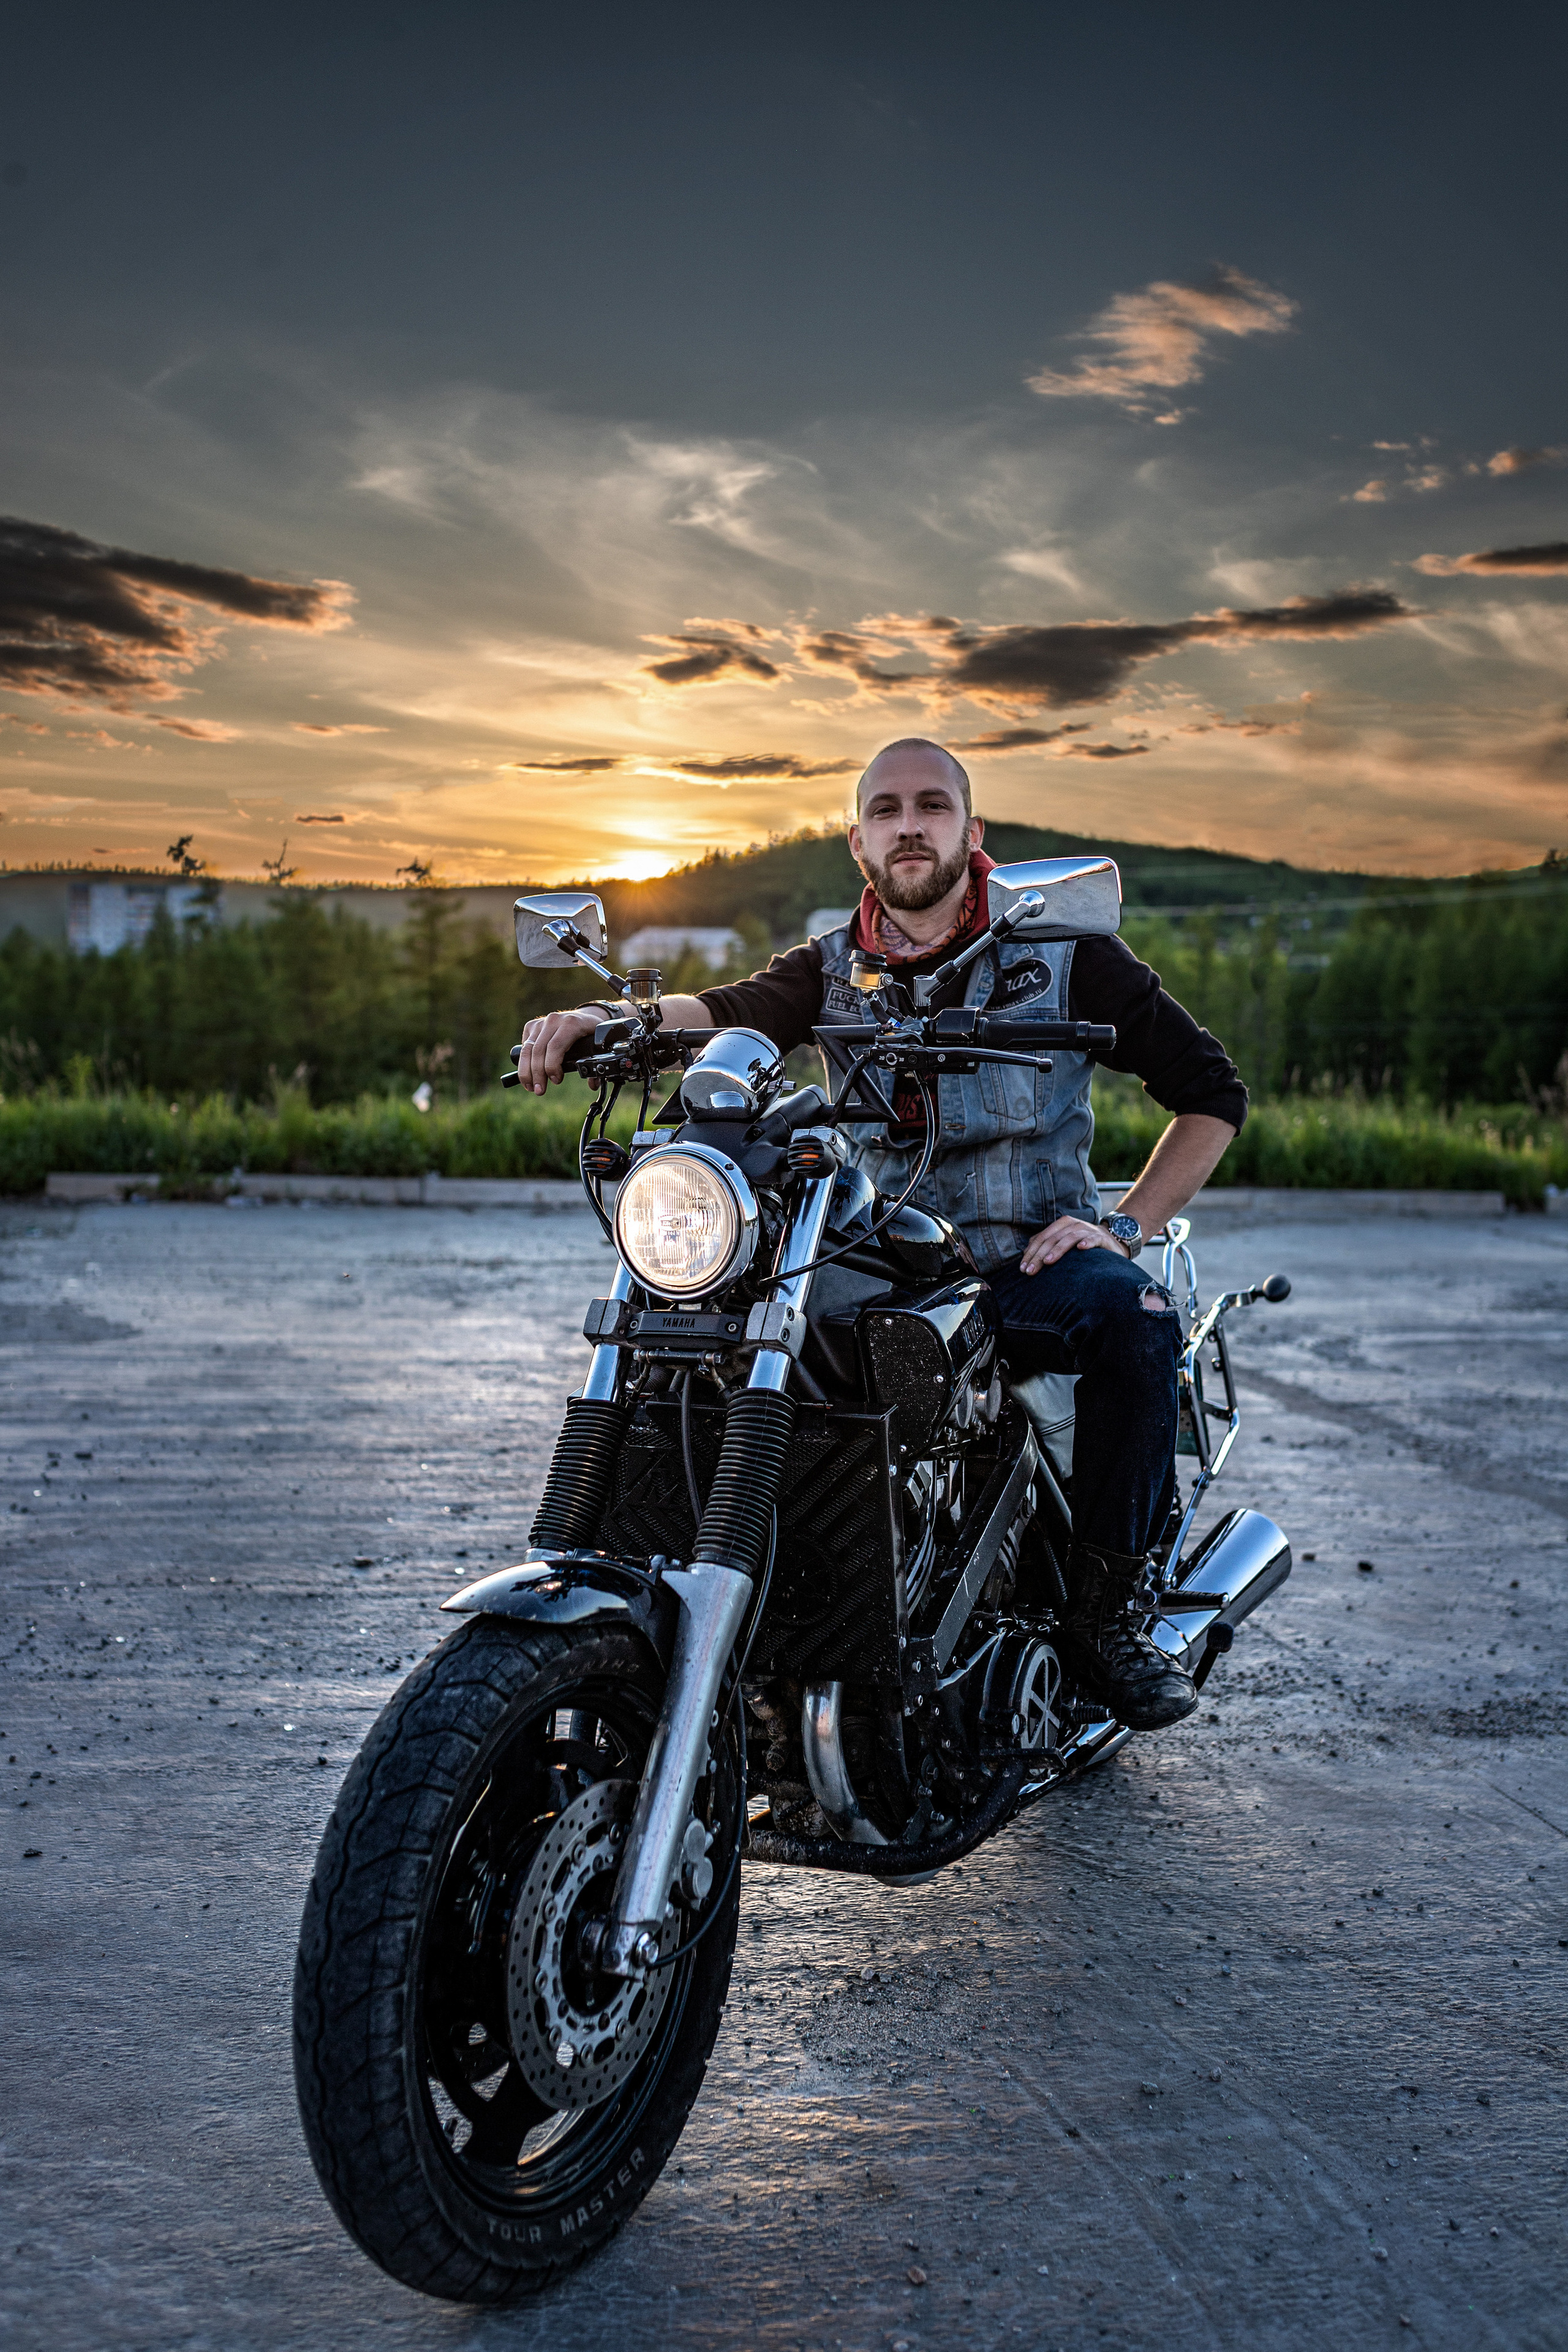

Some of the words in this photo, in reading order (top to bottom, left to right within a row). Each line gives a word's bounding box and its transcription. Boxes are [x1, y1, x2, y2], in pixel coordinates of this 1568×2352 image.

[828, 1000, 847, 1010] FUEL
[663, 1317, 695, 1328] YAMAHA
[486, 2216, 541, 2244] TOUR
[560, 2147, 645, 2236] MASTER
